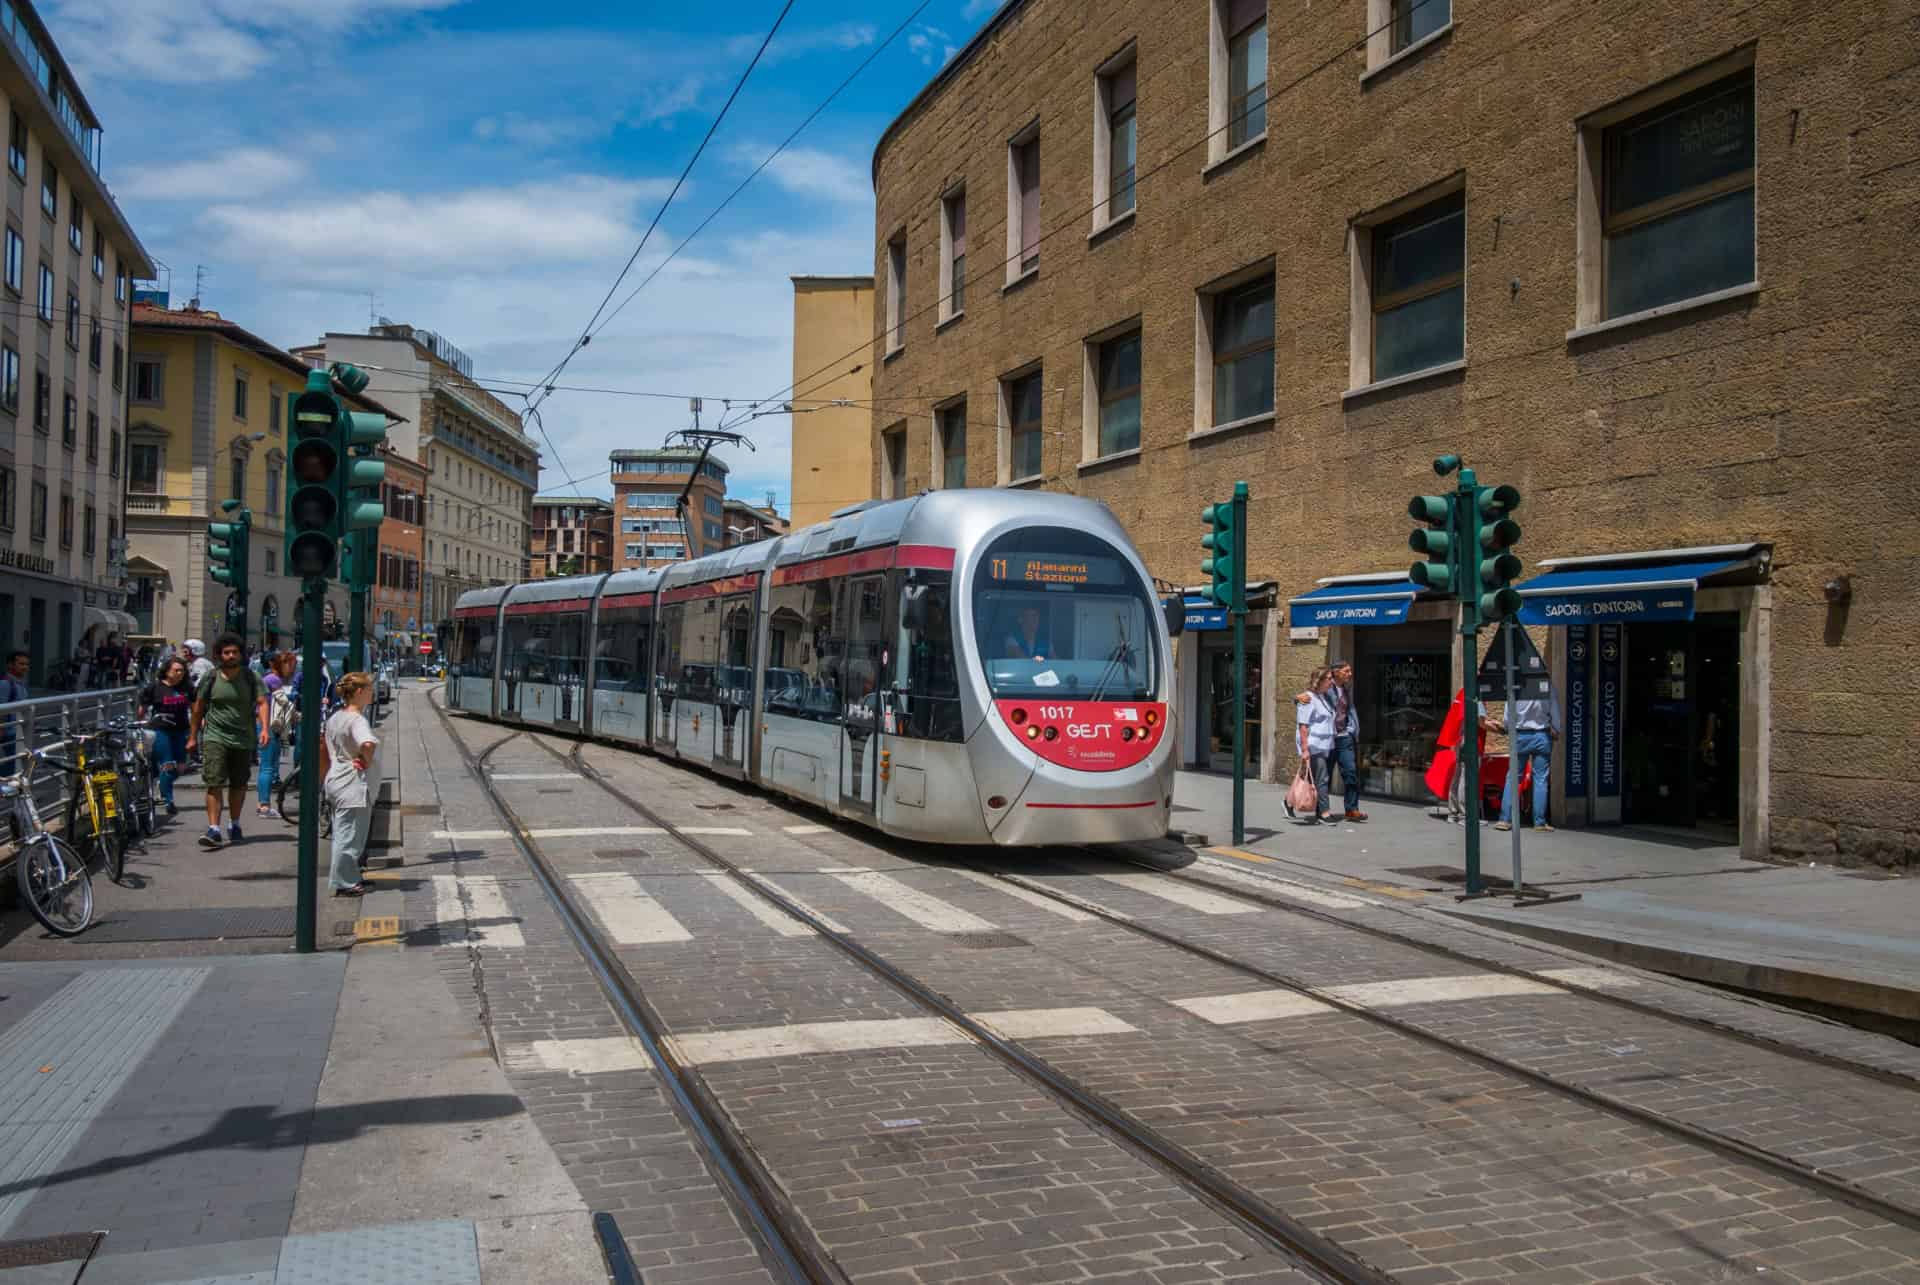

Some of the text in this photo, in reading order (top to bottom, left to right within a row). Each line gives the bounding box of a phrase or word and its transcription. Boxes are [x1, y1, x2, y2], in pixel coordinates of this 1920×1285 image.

[1024, 571, 1088, 583] Stazione
[1545, 603, 1582, 617] SAPORI
[1593, 600, 1646, 615] DINTORNI
[1040, 706, 1074, 719] 1017
[1066, 723, 1113, 738] GEST
[1571, 680, 1584, 785] SUPERMERCATO
[1603, 680, 1616, 785] SUPERMERCATO
